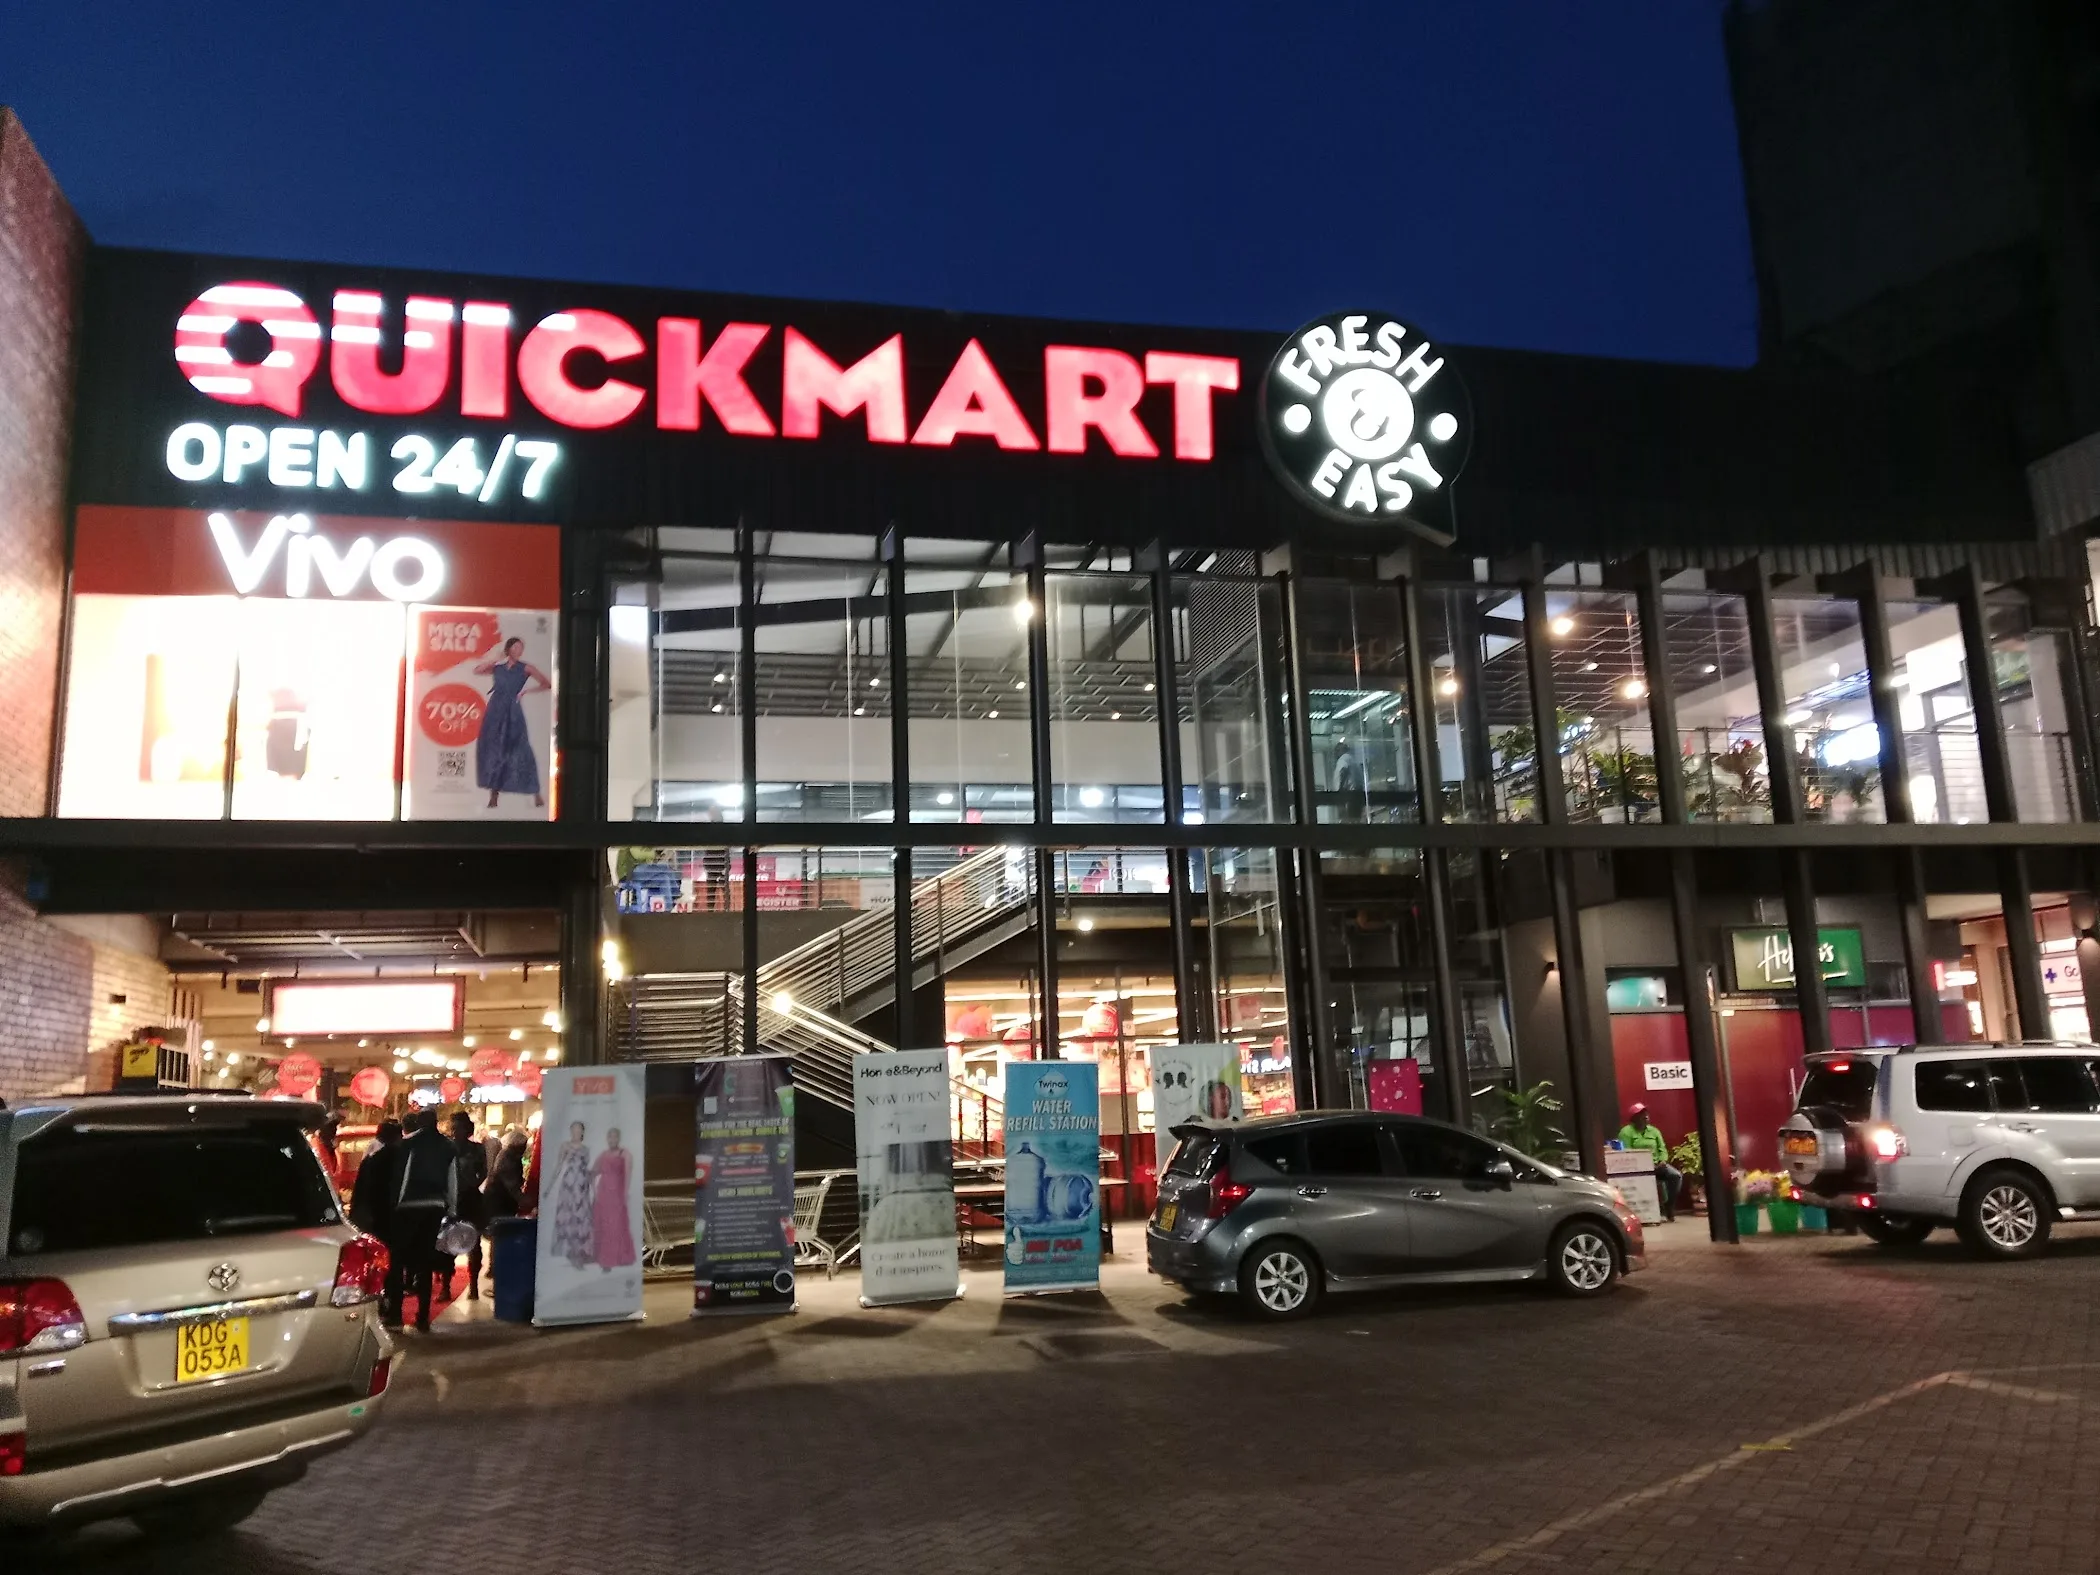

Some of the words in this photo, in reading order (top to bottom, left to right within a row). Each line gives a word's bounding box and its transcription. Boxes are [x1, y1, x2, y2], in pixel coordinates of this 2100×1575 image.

[1279, 315, 1445, 396] FRESH
[174, 281, 1239, 460] QUICKMART
[165, 422, 367, 490] OPEN
[390, 432, 560, 503] 24/7
[1311, 442, 1444, 513] EASY
[206, 511, 446, 602] Vivo
[428, 622, 482, 639] MEGA
[429, 636, 478, 653] SALE
[426, 701, 481, 721] 70%
[438, 719, 469, 733] OFF
[1650, 1065, 1688, 1080] Basic
[865, 1093, 898, 1107] NOW
[1032, 1100, 1072, 1115] WATER
[1006, 1115, 1046, 1132] REFILL
[1048, 1113, 1097, 1130] STATION
[184, 1320, 227, 1349] KDG
[184, 1343, 242, 1375] 053A
